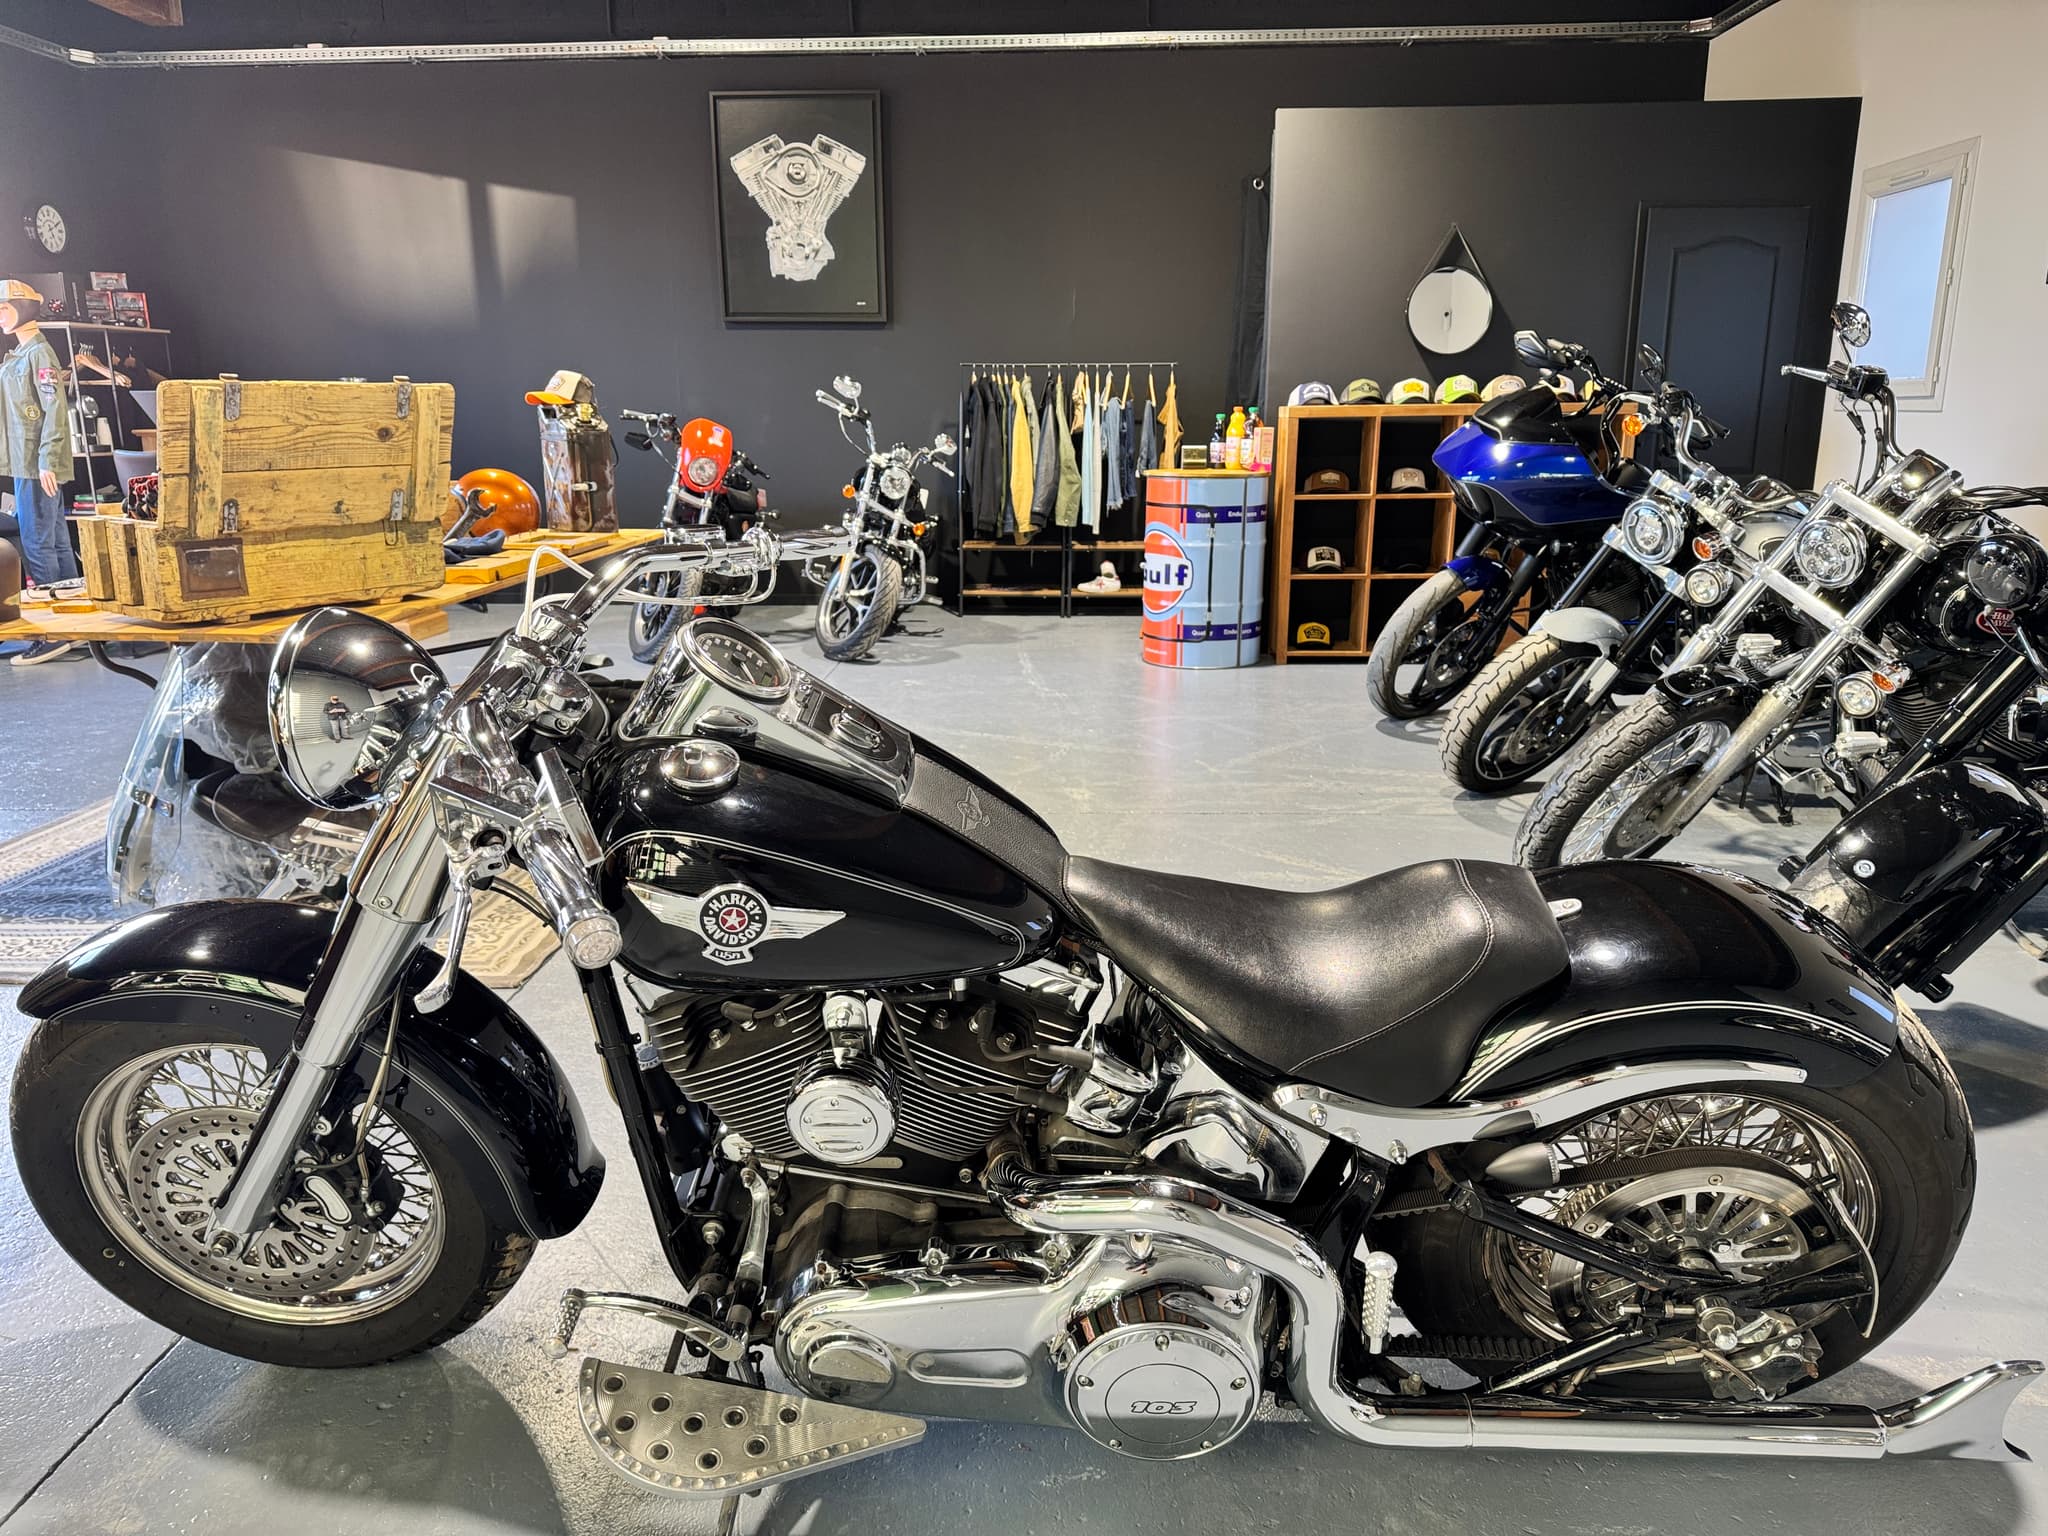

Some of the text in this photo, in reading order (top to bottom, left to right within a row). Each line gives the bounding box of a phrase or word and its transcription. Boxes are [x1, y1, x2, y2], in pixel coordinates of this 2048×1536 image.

[1144, 563, 1189, 586] ulf
[708, 893, 762, 915] HARLEY
[703, 916, 763, 945] DAVIDSON
[1130, 1400, 1197, 1415] 103
